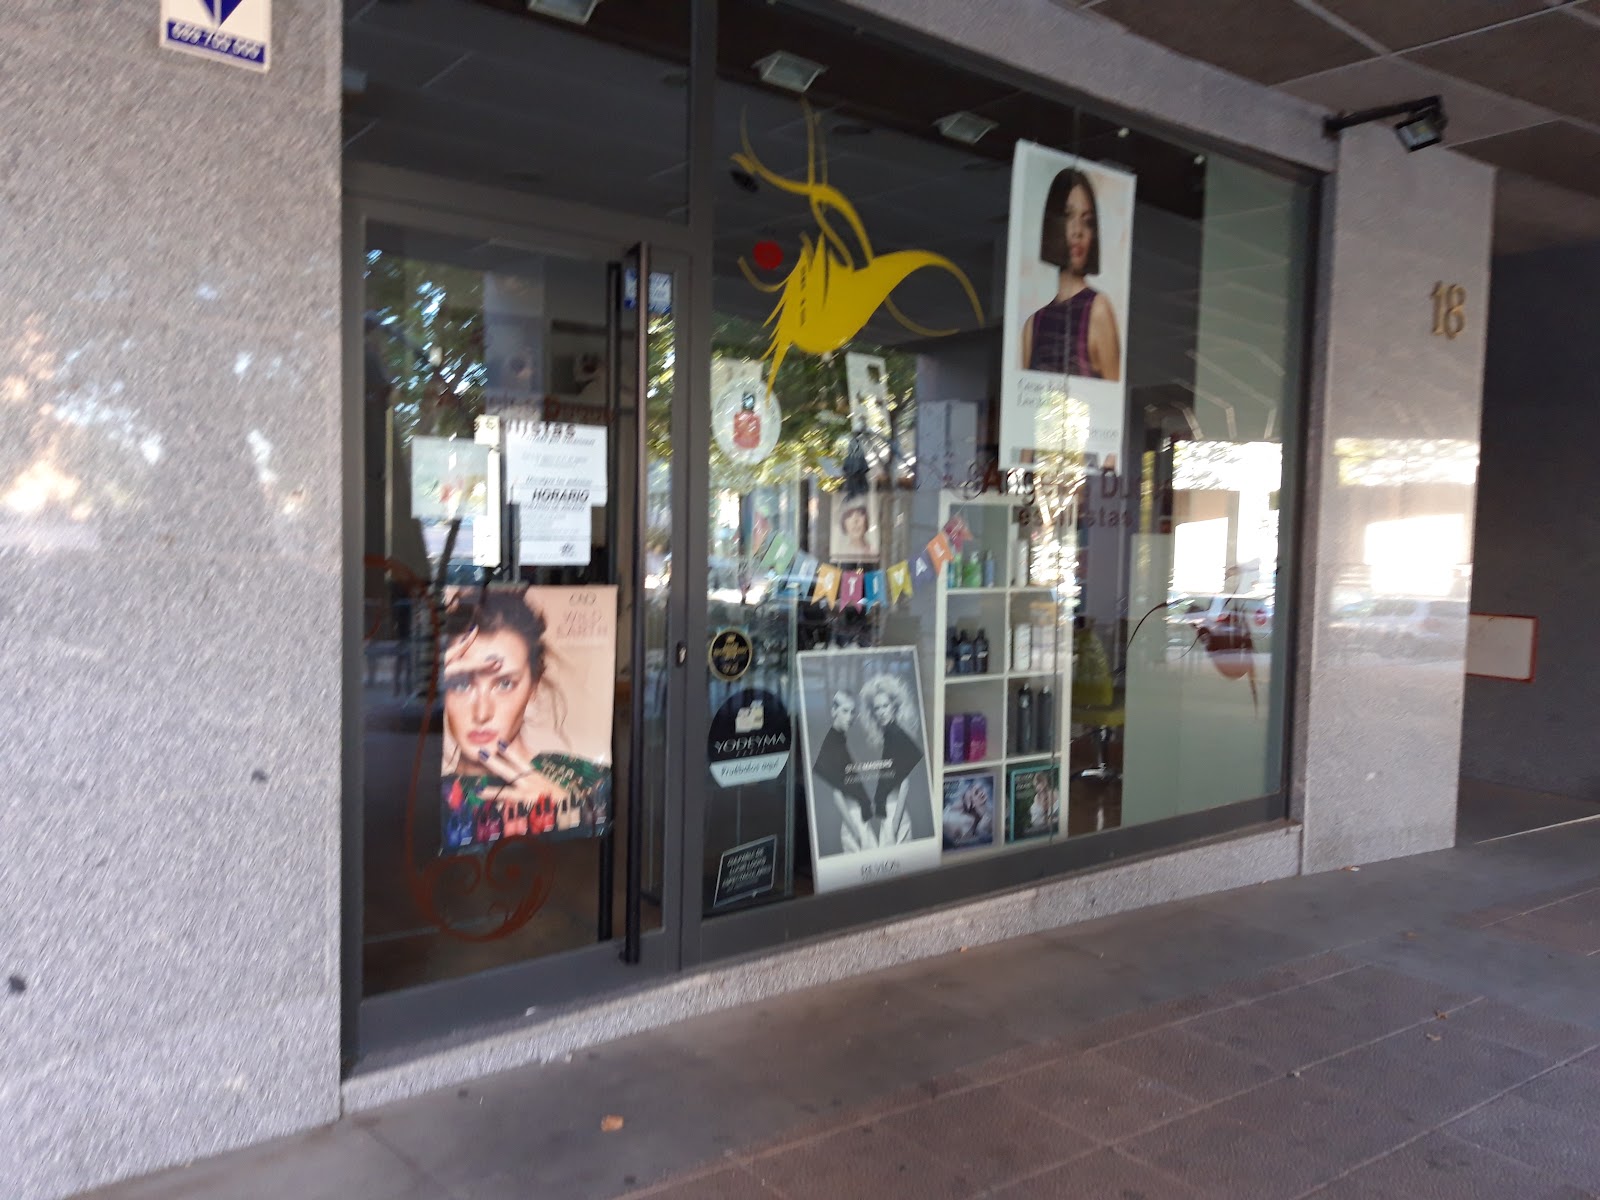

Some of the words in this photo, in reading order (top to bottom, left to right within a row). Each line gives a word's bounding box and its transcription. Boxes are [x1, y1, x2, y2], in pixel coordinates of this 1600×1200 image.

[1430, 280, 1467, 340] 18
[532, 487, 591, 503] HORARIO
[714, 731, 787, 754] YODEYMA
